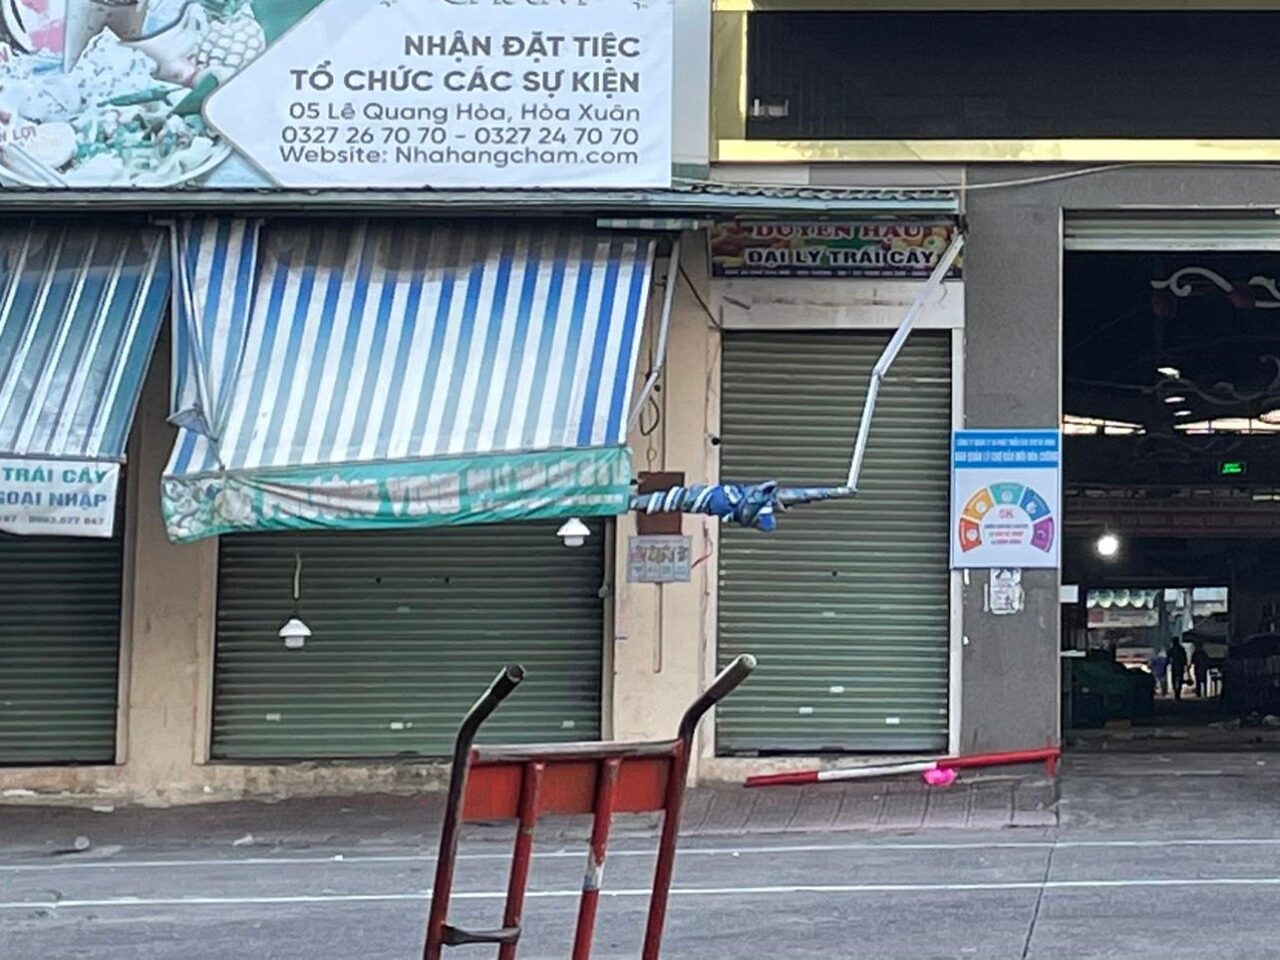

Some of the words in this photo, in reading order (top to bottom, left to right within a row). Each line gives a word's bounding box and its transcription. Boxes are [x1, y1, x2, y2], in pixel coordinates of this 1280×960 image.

[404, 30, 492, 63] NHẬN
[502, 31, 565, 63] ĐẶT
[573, 31, 640, 63] TIỆC
[290, 60, 334, 92] TỔ
[344, 65, 433, 92] CHỨC
[443, 66, 512, 92] CÁC
[522, 69, 565, 98] SỰ
[571, 67, 640, 99] KIỆN
[289, 102, 320, 120] 05
[327, 102, 355, 120] Lê
[363, 103, 448, 124] Quang
[521, 103, 570, 121] Hòa
[578, 103, 640, 122] Xuân
[281, 126, 338, 144] 0327
[346, 126, 374, 144] 26
[381, 126, 410, 144] 70
[418, 126, 447, 144] 70
[475, 127, 531, 144] 0327
[538, 127, 566, 144] 24
[575, 127, 602, 144] 70
[610, 127, 640, 144] 70
[279, 145, 388, 164] Website:
[396, 145, 639, 168] Nhahangcham.com
[2, 464, 53, 482] TRÁI
[62, 467, 108, 484] CÂY
